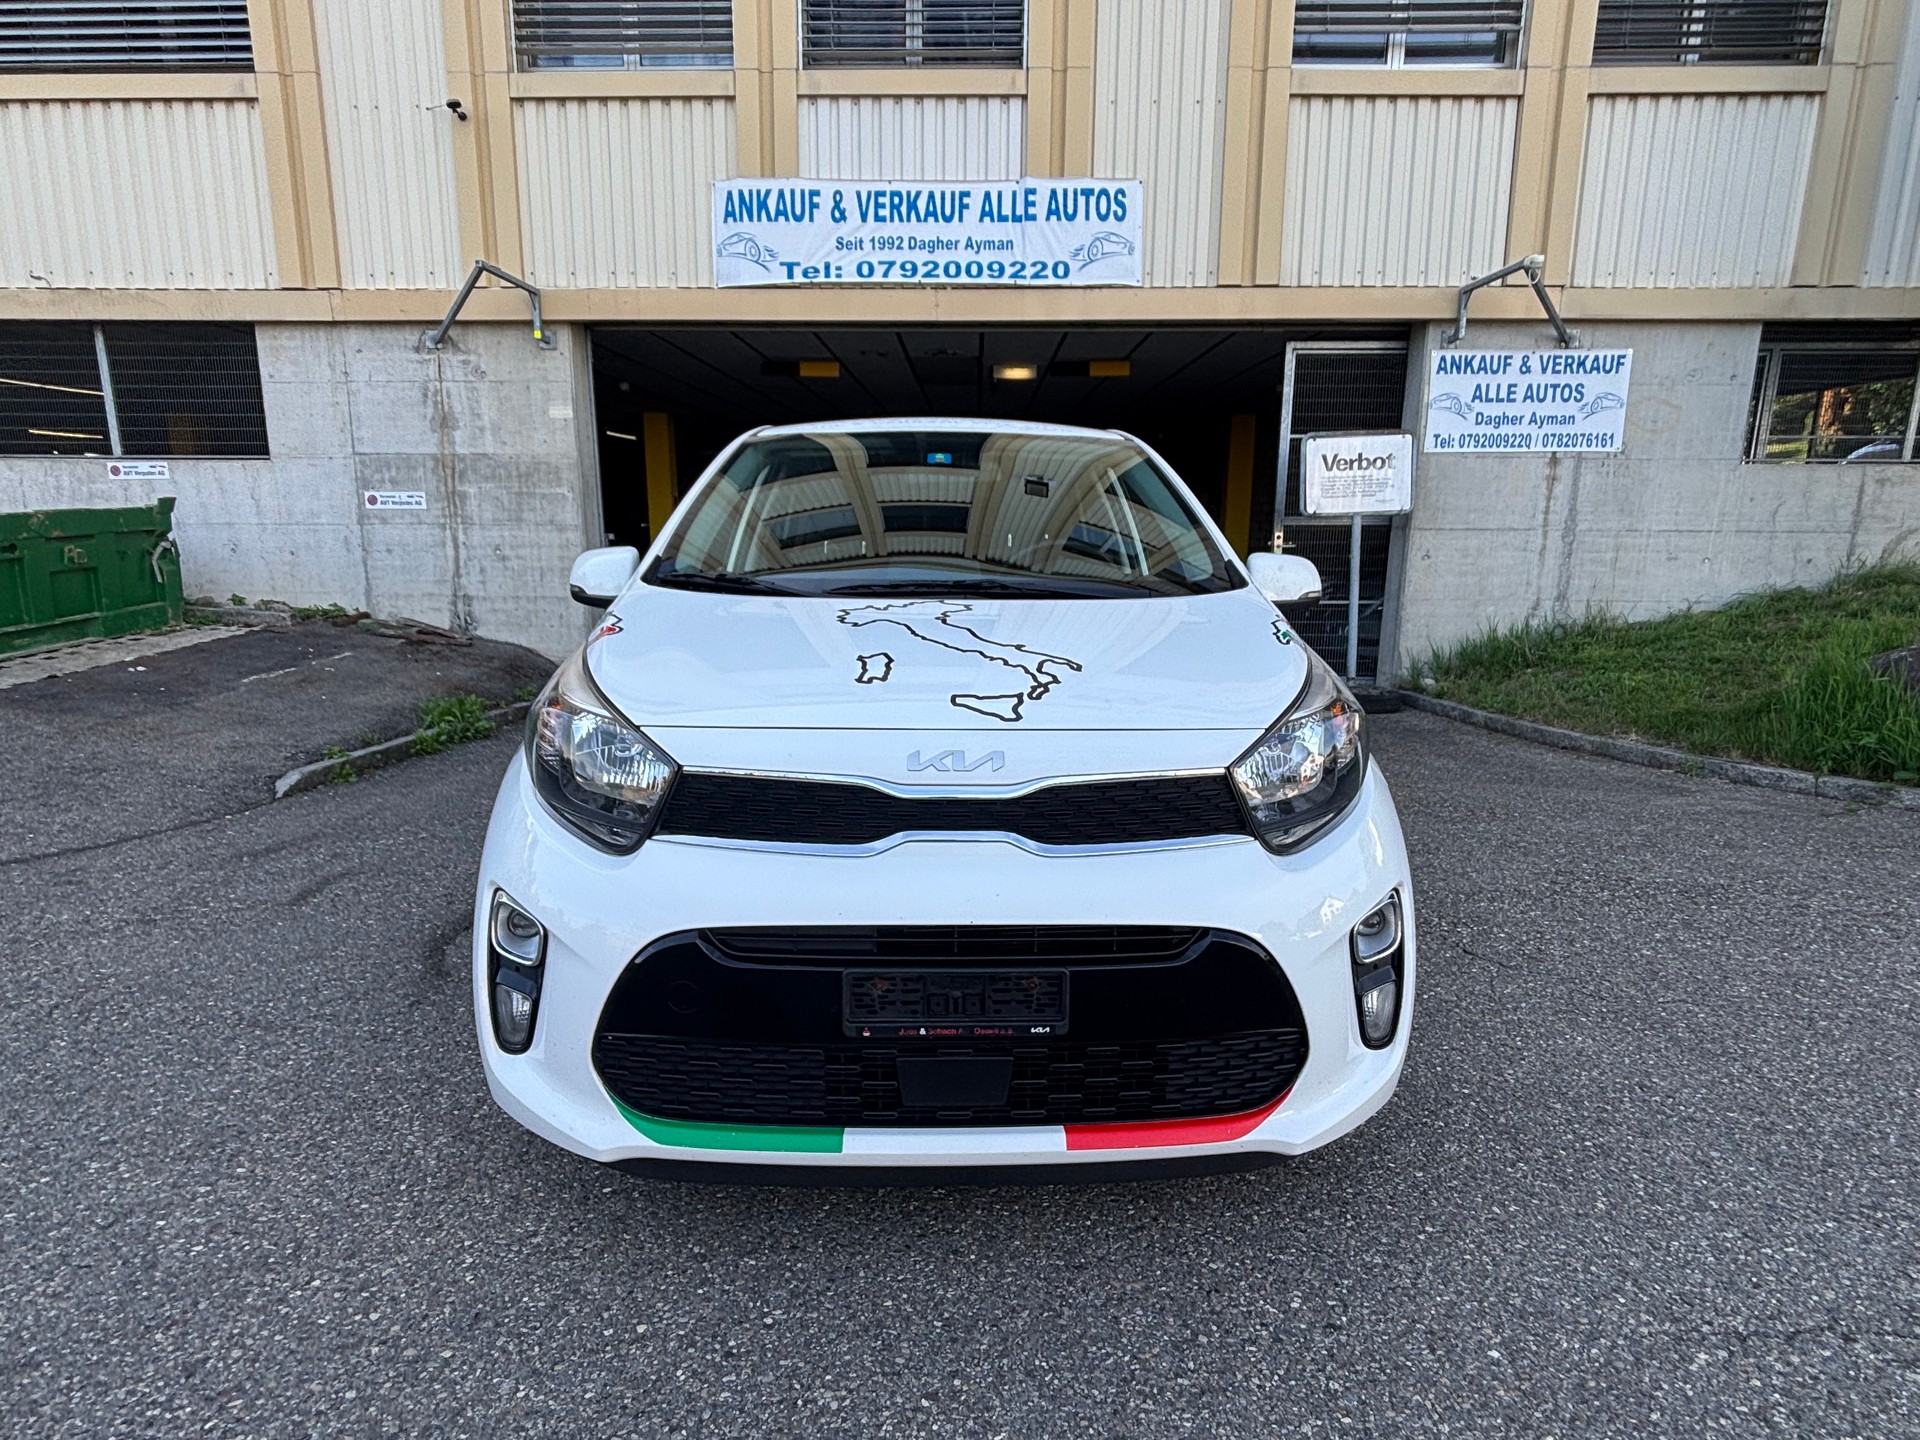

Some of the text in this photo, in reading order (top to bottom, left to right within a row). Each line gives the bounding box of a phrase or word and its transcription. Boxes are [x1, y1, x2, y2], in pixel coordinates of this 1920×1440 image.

[723, 187, 1127, 224] ANKAUF & VERKAUF ALLE AUTOS
[835, 235, 1014, 255] Seit 1992 Dagher Ayman
[779, 260, 1070, 280] Tel: 0792009220
[1436, 354, 1627, 375] ANKAUF & VERKAUF
[1471, 382, 1585, 403] ALLE AUTOS
[1474, 411, 1576, 429] Dagher Ayman
[1433, 433, 1455, 449] Tel:
[1542, 432, 1615, 448] 0782076161
[1321, 452, 1396, 472] Verbot
